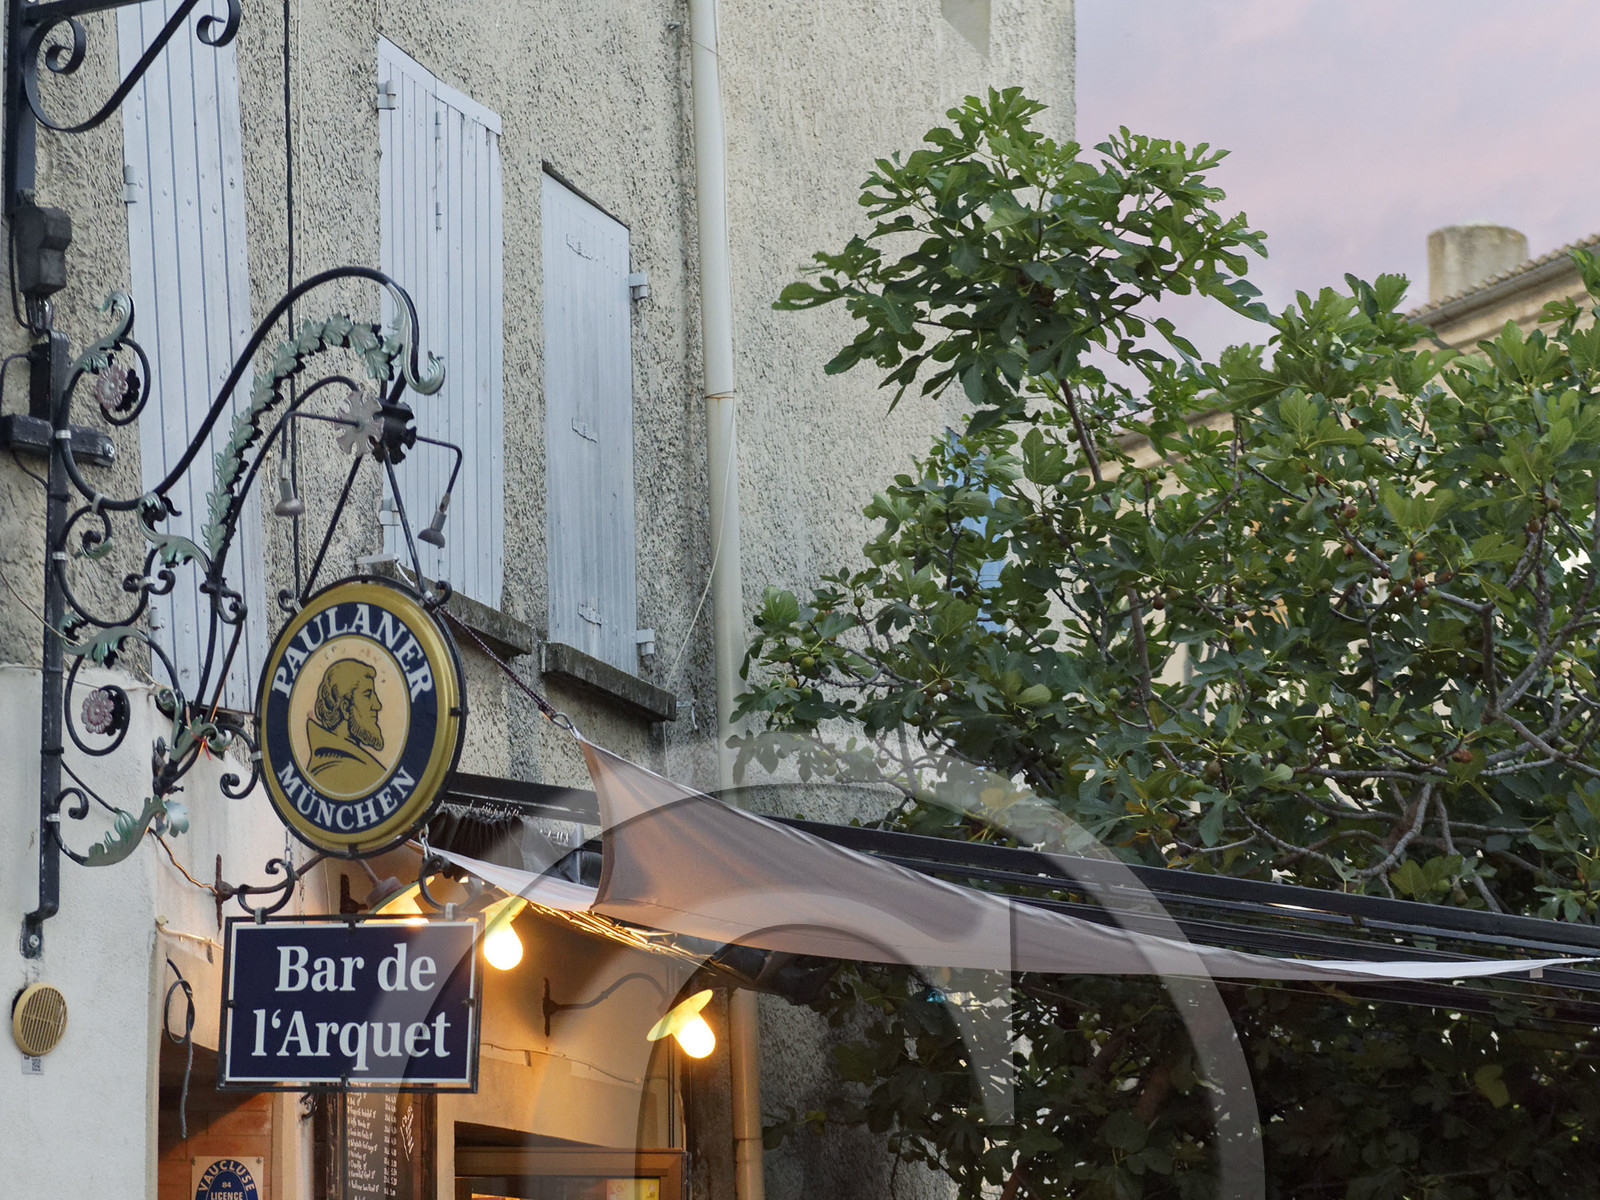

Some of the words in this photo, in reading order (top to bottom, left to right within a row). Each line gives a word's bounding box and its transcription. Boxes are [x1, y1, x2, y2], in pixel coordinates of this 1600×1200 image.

[271, 604, 433, 703] PAULANER
[277, 761, 416, 831] MÜNCHEN
[275, 945, 365, 992] Bar
[377, 942, 437, 992] de
[198, 1160, 255, 1192] VAUCLUSE
[210, 1192, 243, 1200] LICENCE
